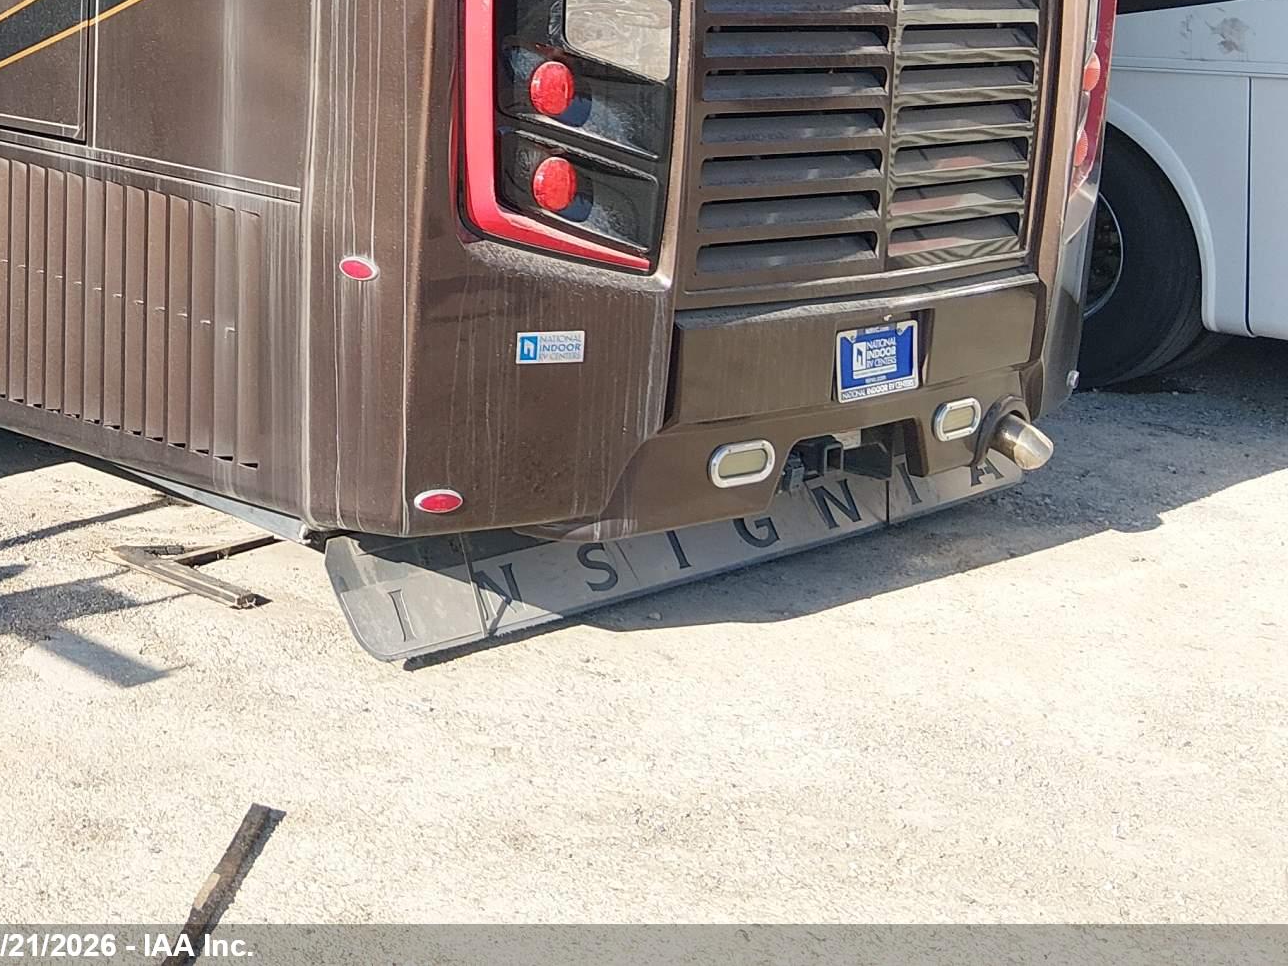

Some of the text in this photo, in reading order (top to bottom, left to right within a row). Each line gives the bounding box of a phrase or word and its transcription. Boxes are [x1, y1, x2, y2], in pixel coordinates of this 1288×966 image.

[540, 334, 582, 343] NATIONAL
[866, 337, 897, 350] NATIONAL
[540, 343, 582, 352] INDOOR
[867, 346, 897, 360] INDOOR
[866, 384, 888, 395] INDOOR
[386, 458, 1005, 642] INSIGNIA
